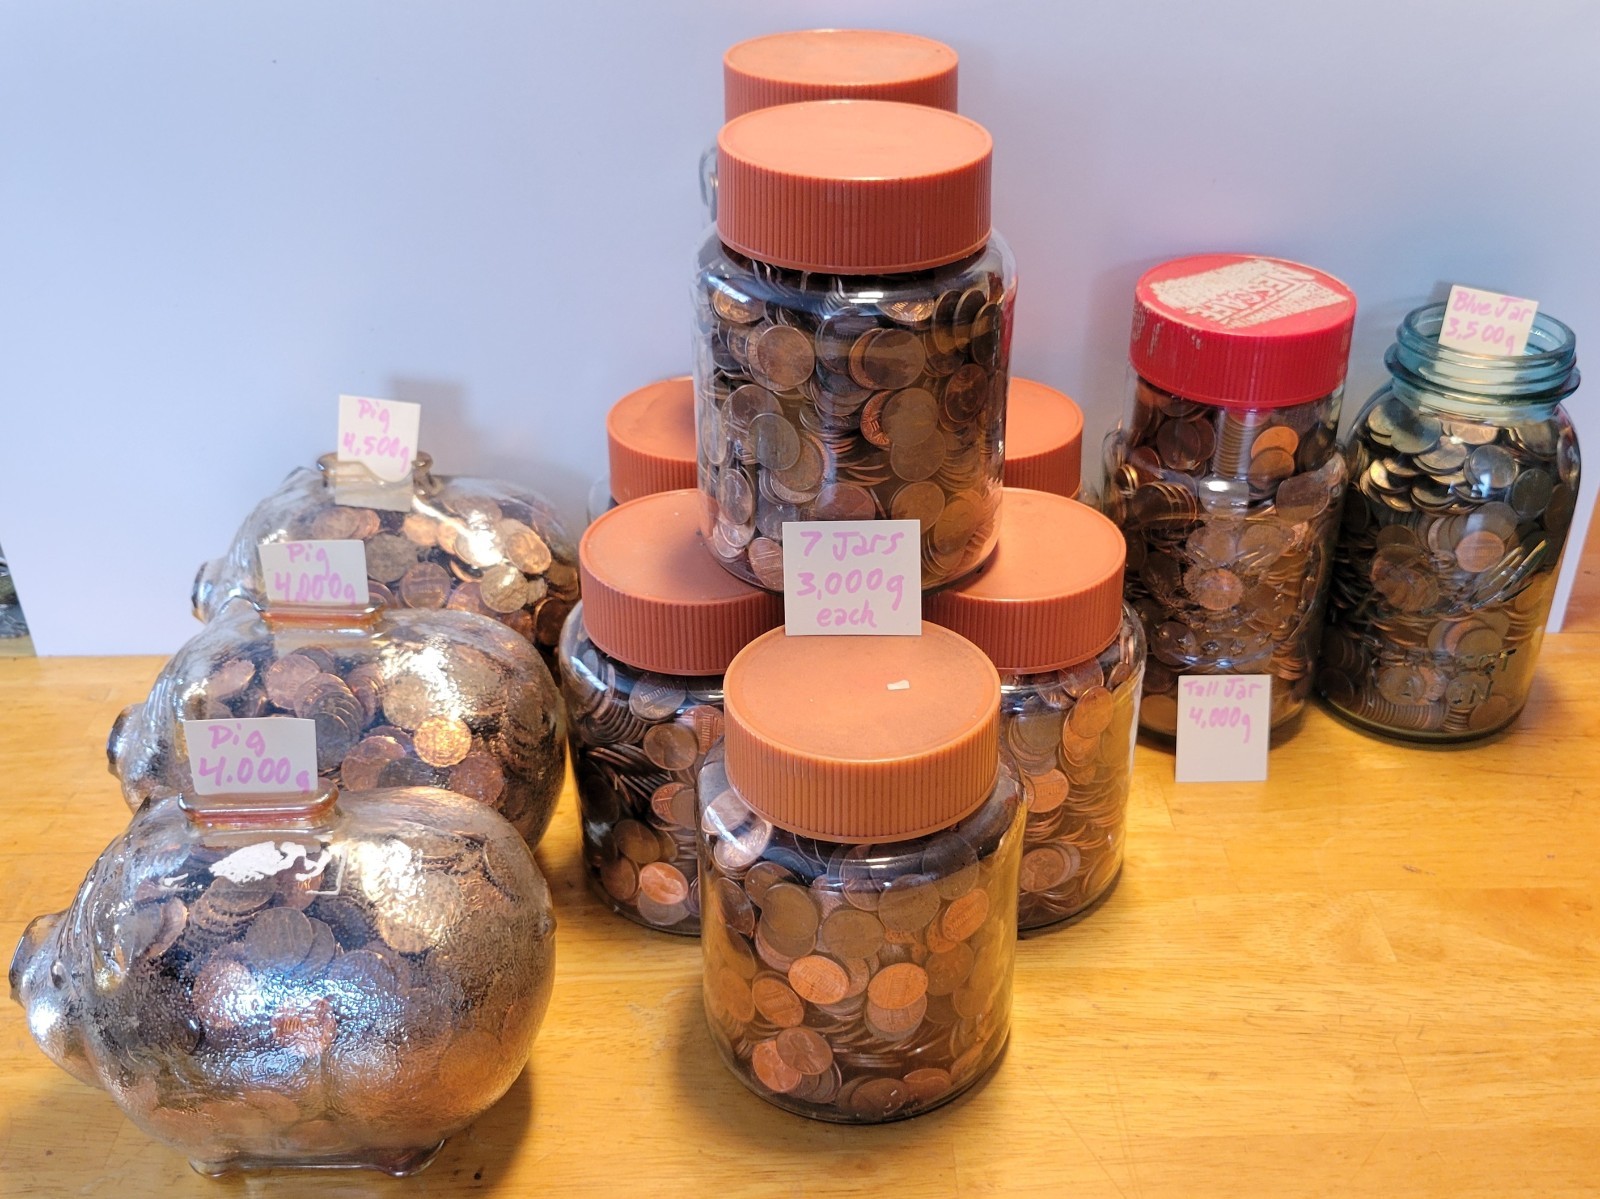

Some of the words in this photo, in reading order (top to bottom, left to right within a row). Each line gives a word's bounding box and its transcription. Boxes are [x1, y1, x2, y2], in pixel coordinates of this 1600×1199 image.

[1453, 290, 1492, 316] Blue
[1495, 297, 1532, 322] Jar
[1445, 317, 1515, 356] 3,500g
[358, 399, 390, 434] Pig
[343, 432, 409, 473] 4,500g
[286, 543, 330, 580] Pig
[800, 531, 823, 557] 7
[832, 531, 904, 561] Jars
[797, 568, 904, 611] 3,000g
[816, 599, 878, 629] each
[1183, 680, 1219, 697] Tall
[1224, 677, 1262, 700] Jar
[208, 722, 266, 757] Pig
[1189, 706, 1251, 744] 4,000g
